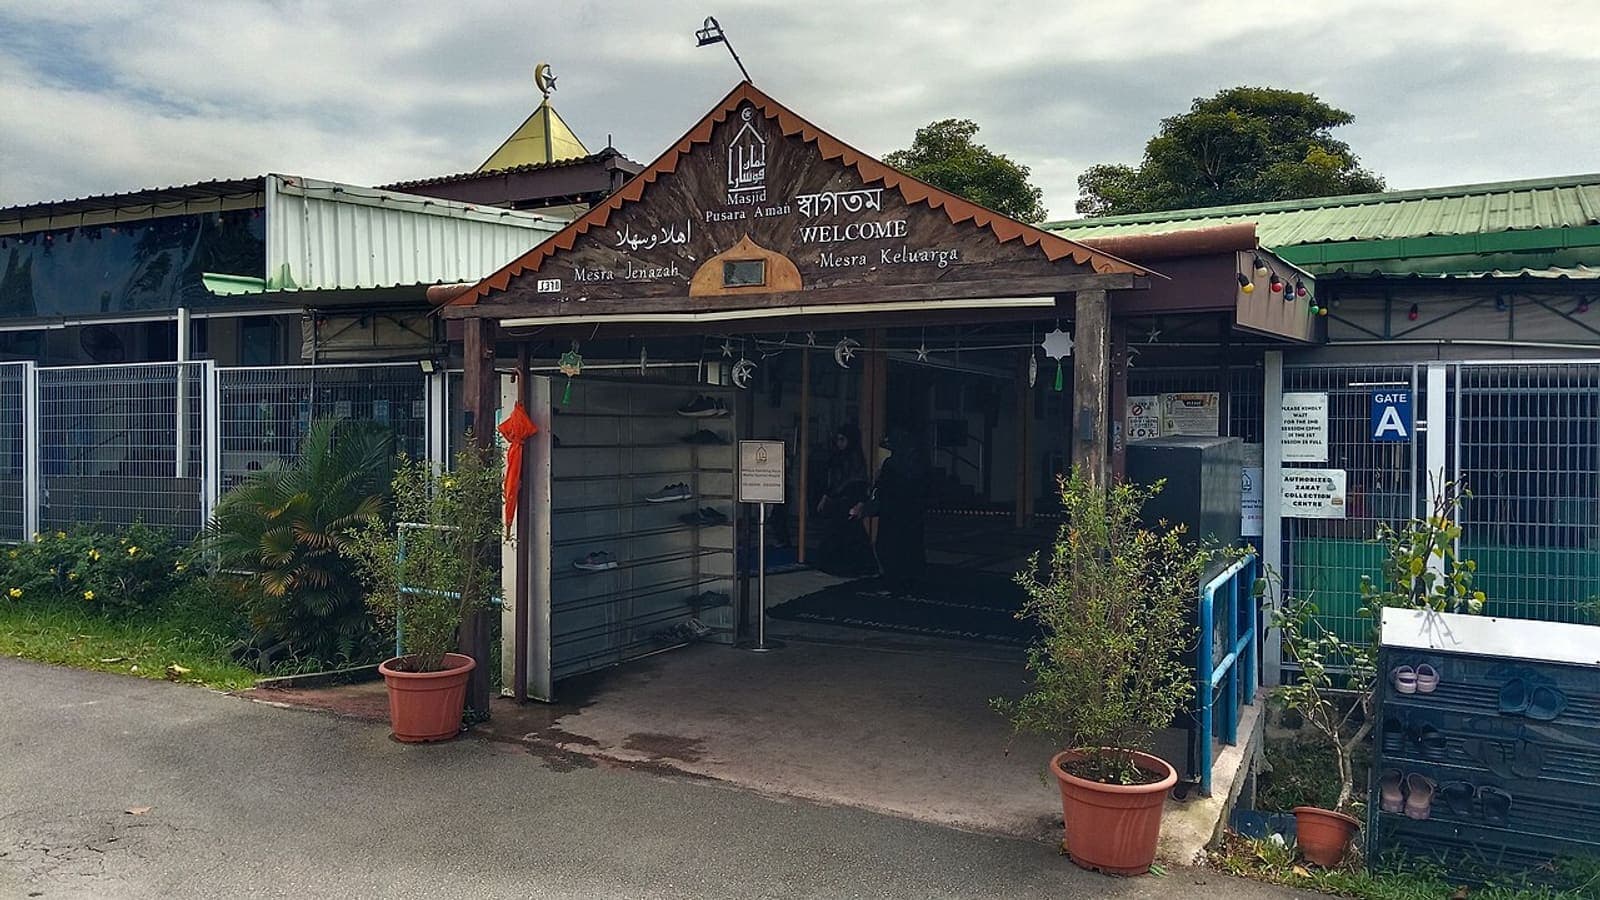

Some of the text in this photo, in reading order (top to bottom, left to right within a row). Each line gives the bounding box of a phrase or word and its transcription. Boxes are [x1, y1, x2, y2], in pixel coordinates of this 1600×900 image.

[727, 190, 767, 206] Masjid
[795, 188, 884, 218] স্বাগতম
[705, 202, 791, 223] Pusara Aman
[799, 220, 908, 244] WELCOME
[819, 246, 959, 269] Mesra Keluarga
[574, 261, 679, 282] Mesra Jenazah
[1374, 393, 1408, 404] GATE
[1374, 406, 1408, 437] A
